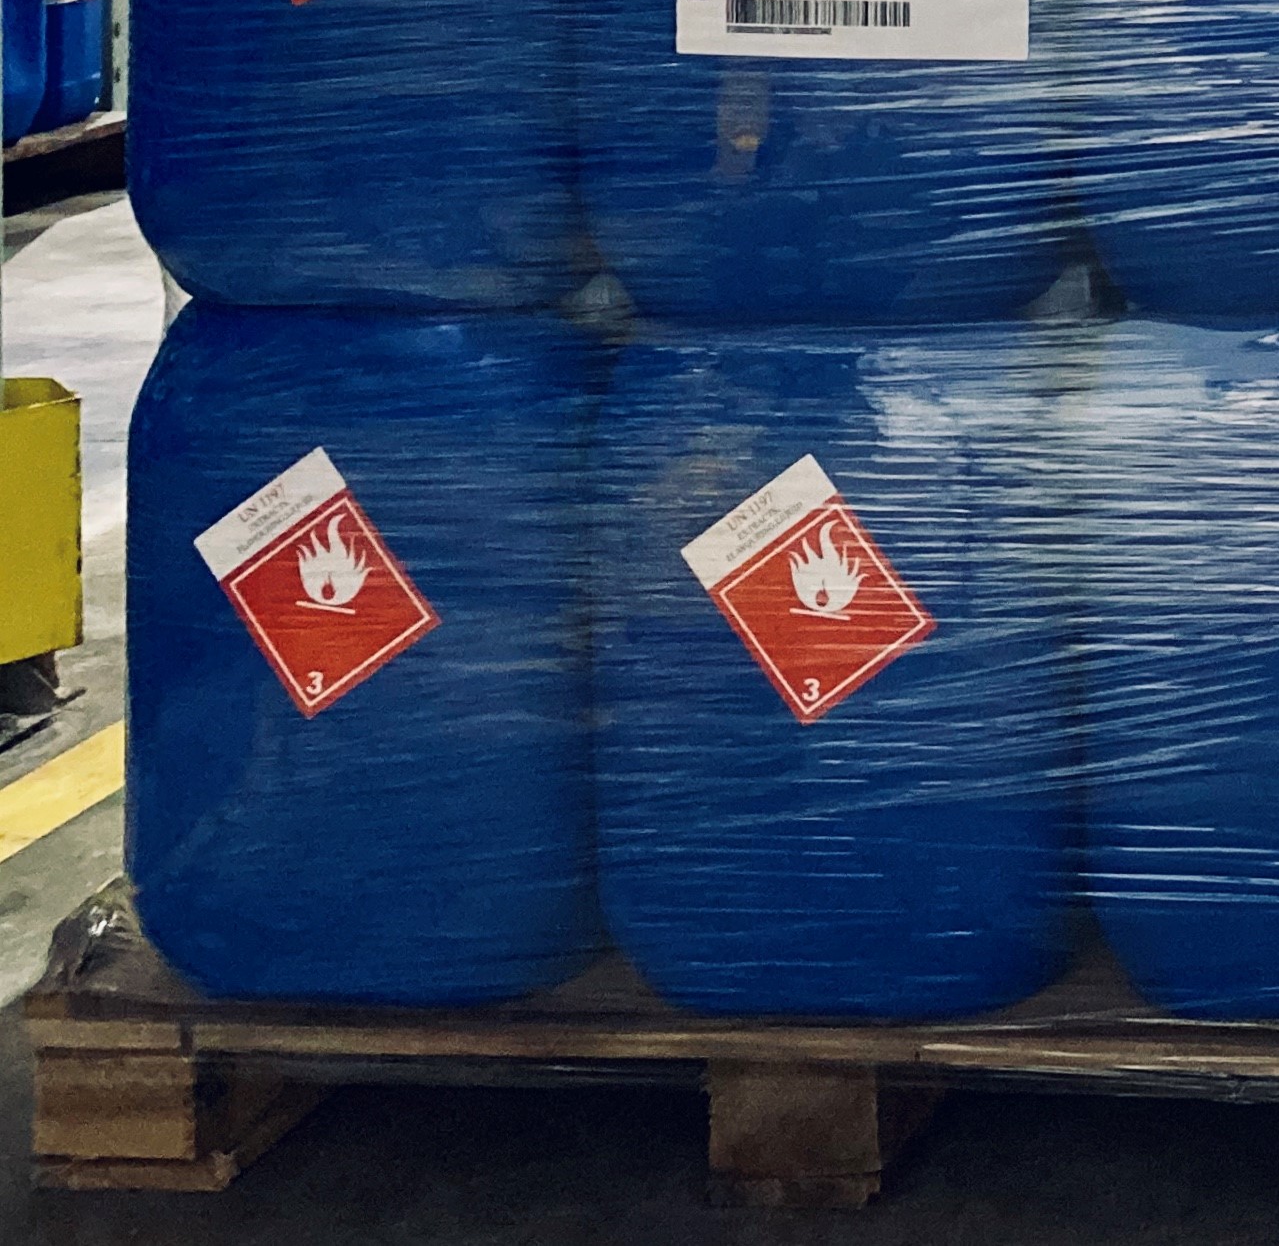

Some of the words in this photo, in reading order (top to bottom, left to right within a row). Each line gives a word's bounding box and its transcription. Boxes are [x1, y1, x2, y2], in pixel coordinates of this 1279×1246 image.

[239, 504, 258, 522] UN
[727, 511, 747, 531] UN
[748, 491, 774, 514] 1197
[305, 670, 323, 697] 3
[801, 677, 820, 702] 3
